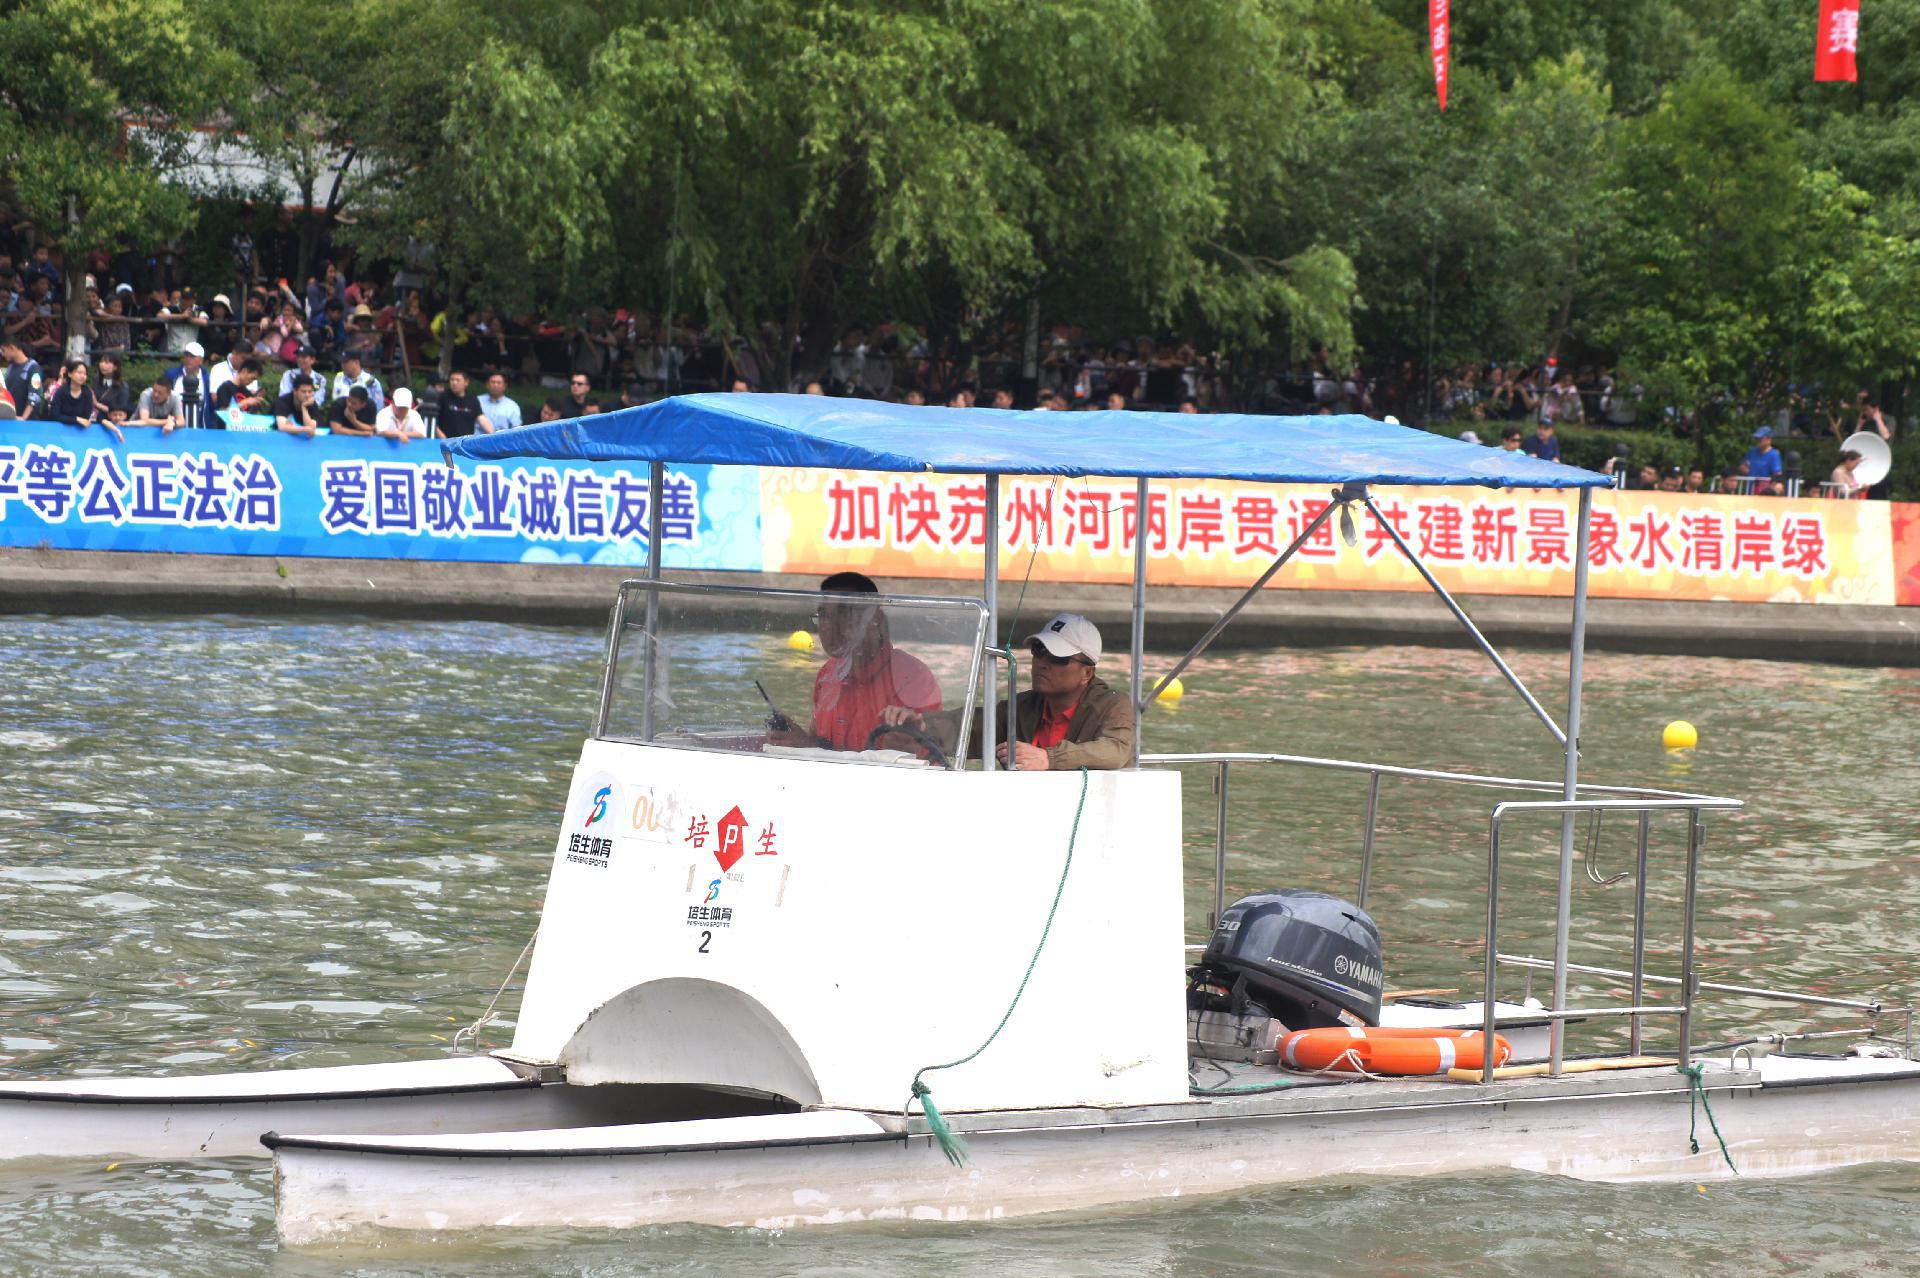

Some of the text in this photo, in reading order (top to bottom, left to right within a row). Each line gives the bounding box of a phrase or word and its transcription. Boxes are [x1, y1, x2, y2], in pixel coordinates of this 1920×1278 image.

[325, 465, 695, 540] 爱国敬业诚信友善
[568, 833, 613, 859] 培生体育
[687, 905, 733, 922] 培生体育
[698, 930, 712, 954] 2
